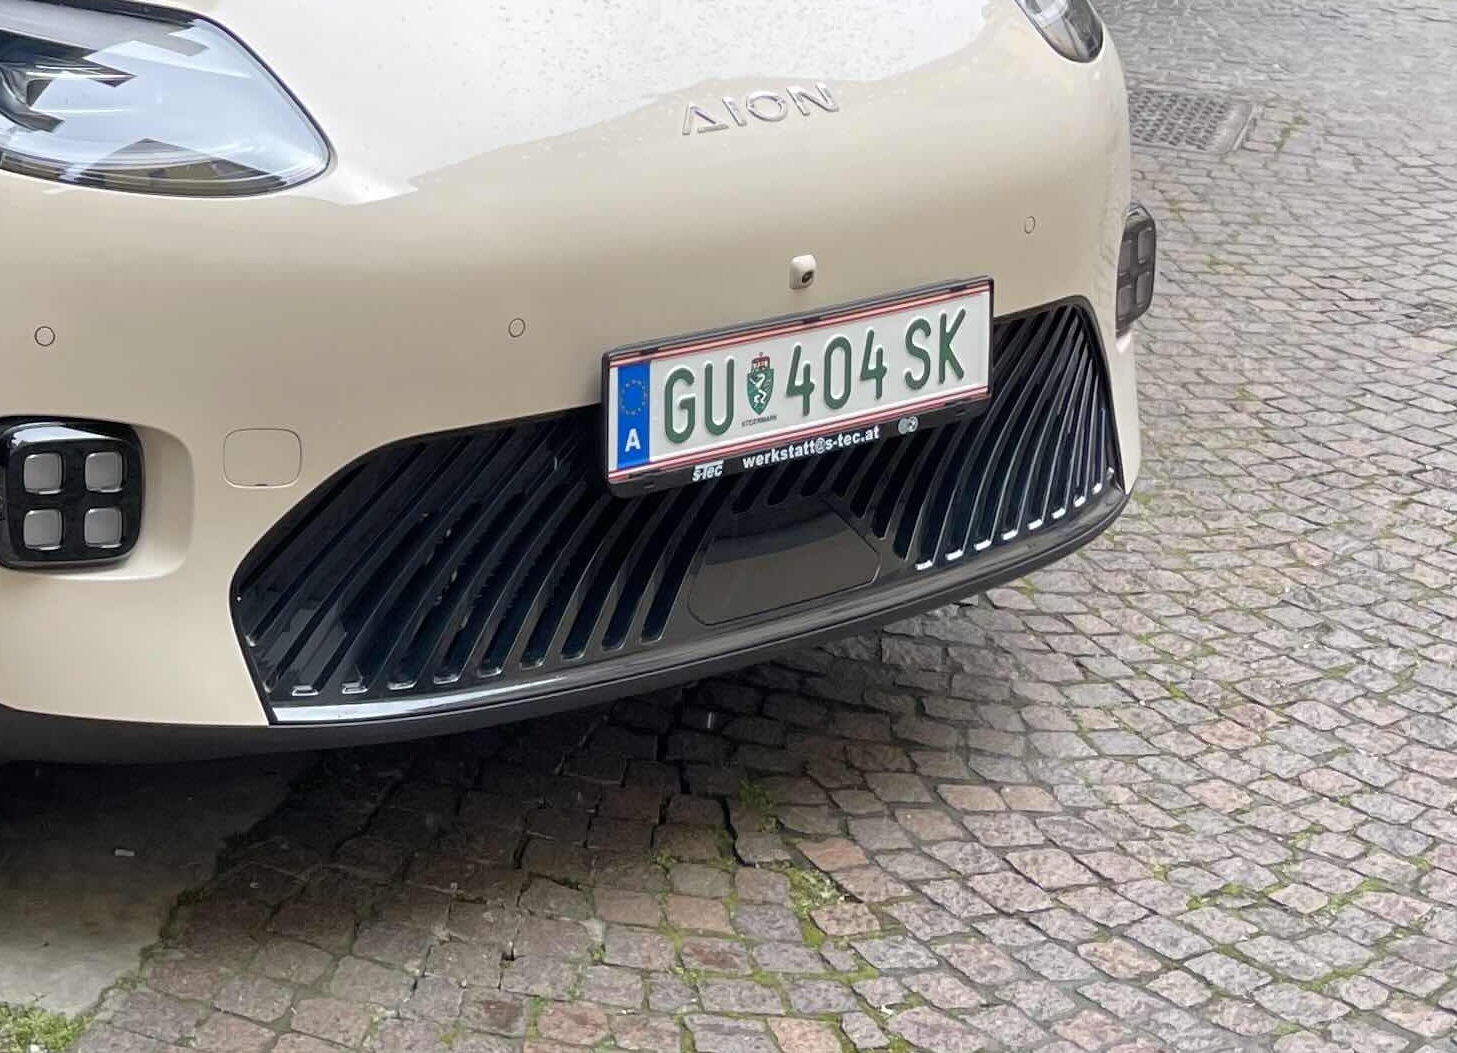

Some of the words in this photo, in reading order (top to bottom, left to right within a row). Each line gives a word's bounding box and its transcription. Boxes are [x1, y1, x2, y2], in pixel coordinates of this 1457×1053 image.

[682, 81, 840, 136] AION
[664, 355, 735, 444] GU
[785, 326, 888, 417] 404
[904, 306, 967, 390] SK
[624, 427, 641, 452] A
[742, 423, 881, 470] werkstatt@s-tec.at
